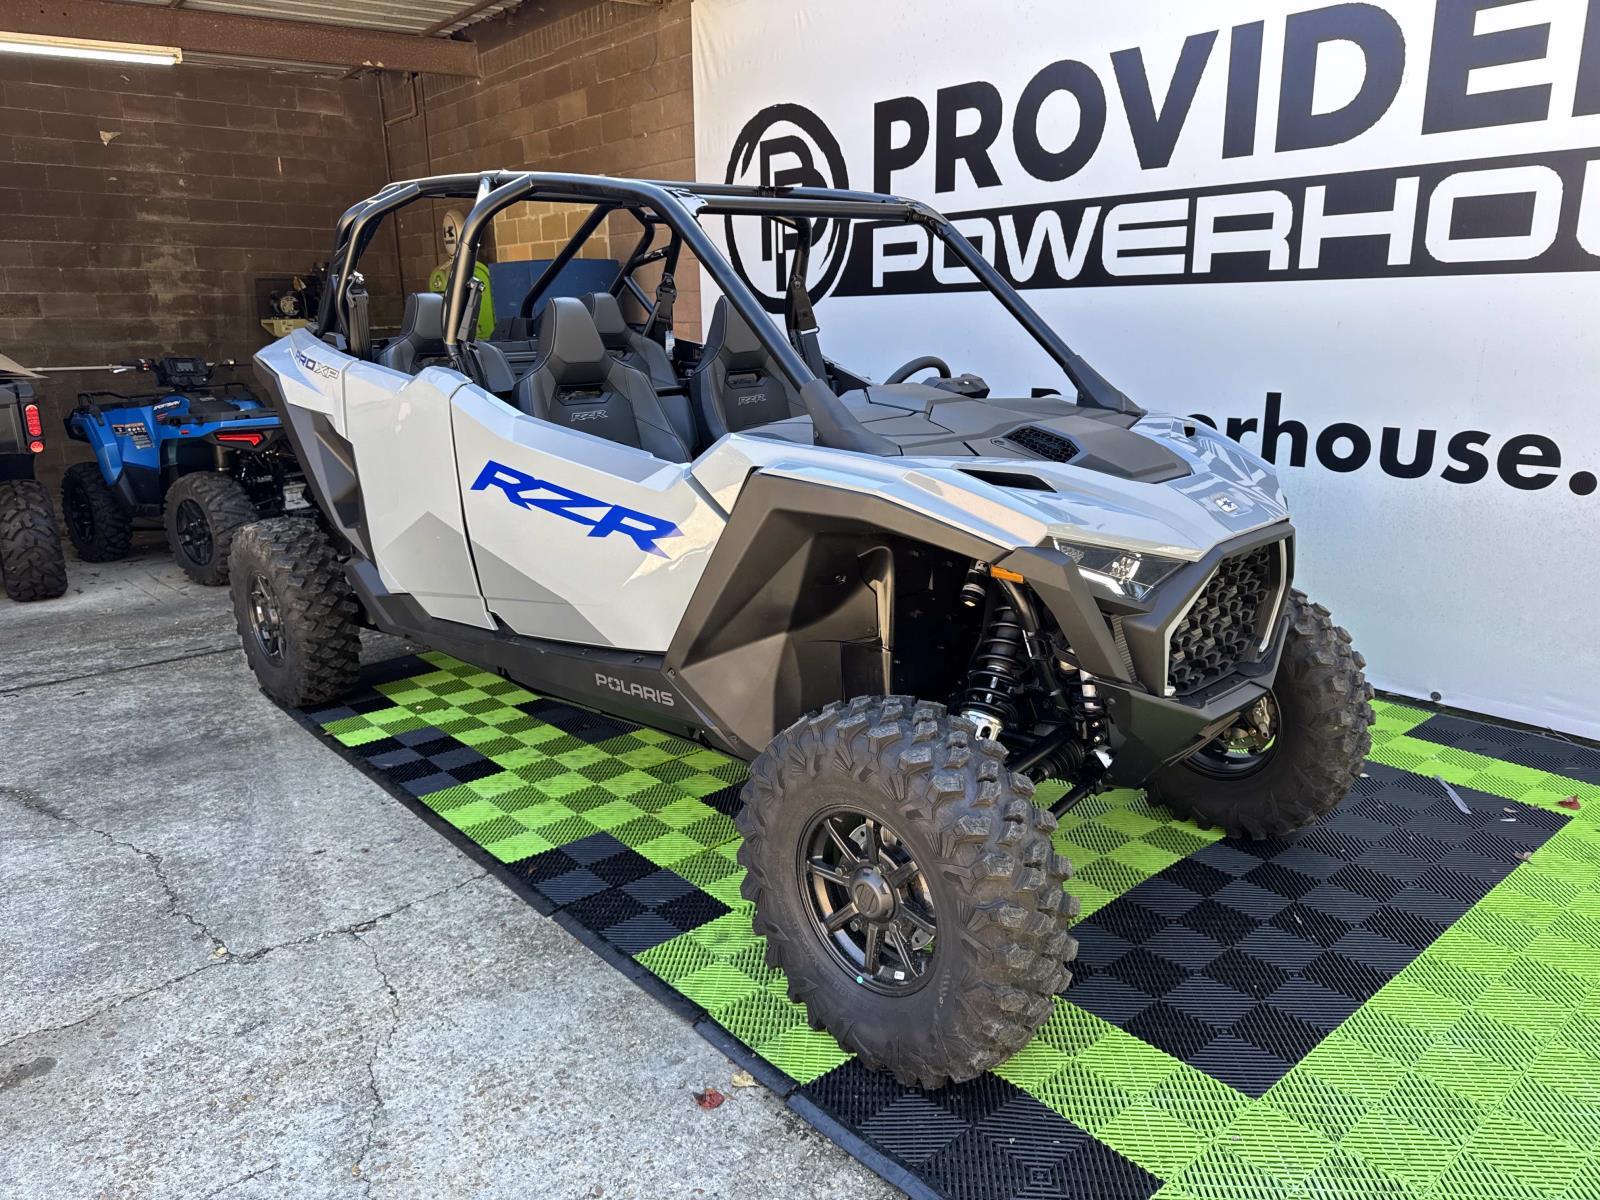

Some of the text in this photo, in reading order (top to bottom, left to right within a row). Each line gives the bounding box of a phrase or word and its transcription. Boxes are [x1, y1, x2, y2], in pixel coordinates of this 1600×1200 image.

[873, 0, 1600, 196] PROVIDE
[872, 160, 1600, 288] POWERHO
[570, 409, 609, 422] RZR
[738, 393, 766, 405] RZR
[470, 460, 685, 560] RZR
[594, 672, 675, 706] POLARIS
